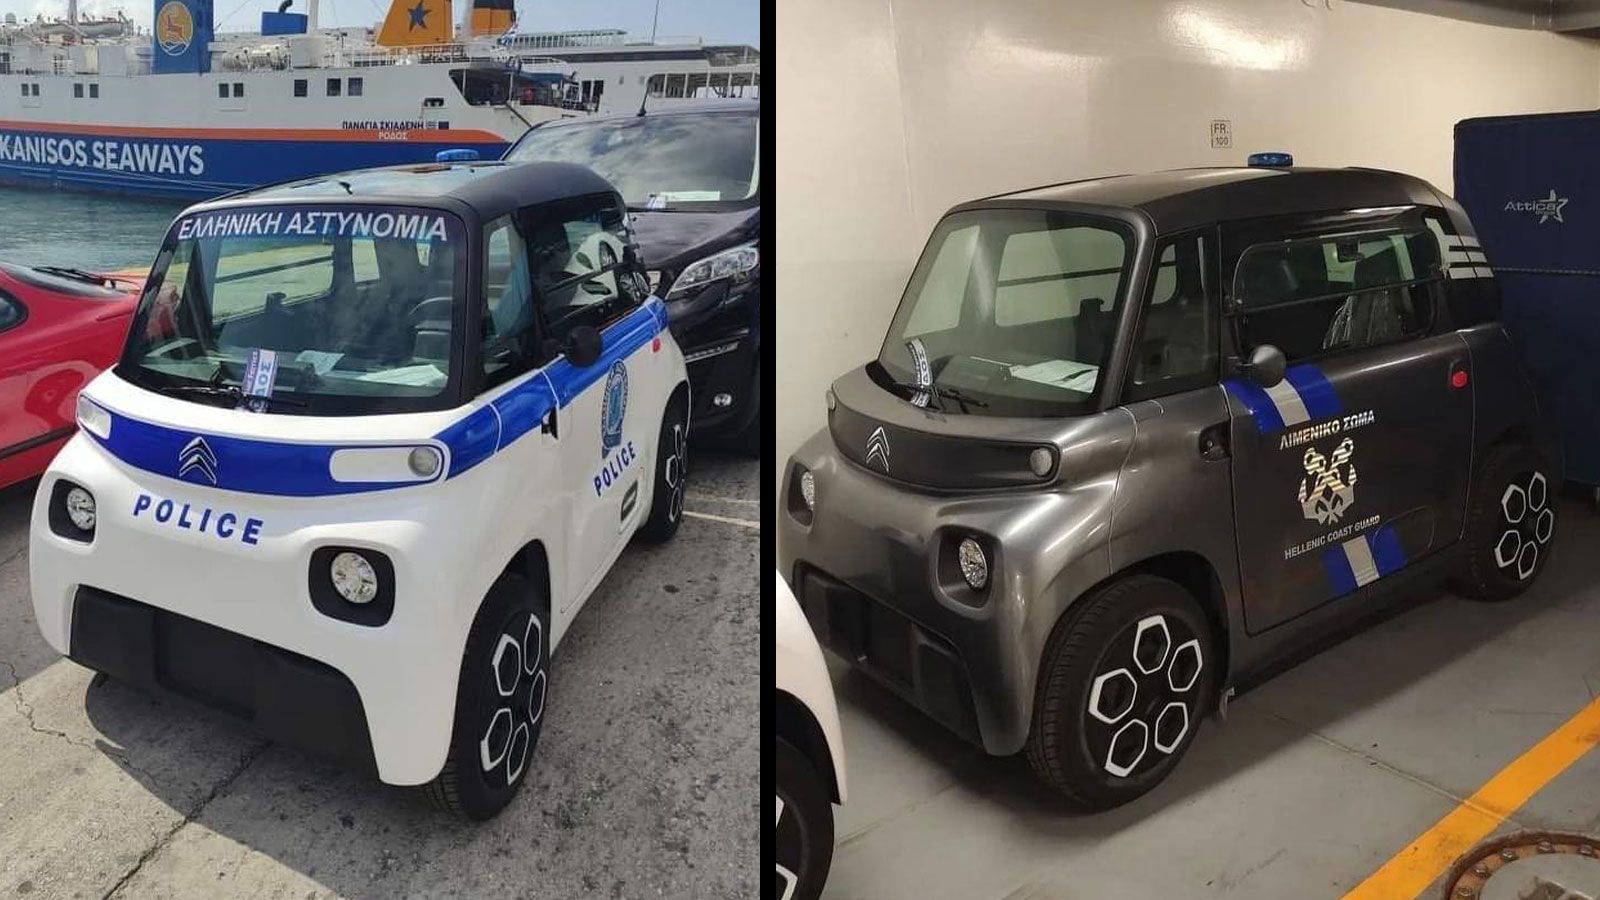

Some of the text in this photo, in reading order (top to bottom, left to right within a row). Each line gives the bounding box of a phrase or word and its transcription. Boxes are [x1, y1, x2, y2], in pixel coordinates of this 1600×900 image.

[342, 121, 424, 131] ΠΑΝΑΓΙΑ ΣΚΙΑΔΕΝΗ
[378, 131, 408, 140] ΡΟΔΟΣ
[0, 134, 205, 175] KANISOS SEAWAYS
[178, 212, 448, 242] ΕΛΛΗΝΙΚΗ ΑΣΤΥΝΟΜΙΑ
[1279, 410, 1376, 450] ΛΙΜΕΝΙΚΟ ΣΩΜΑ
[594, 441, 636, 497] POLICE
[132, 494, 264, 546] POLICE
[1283, 514, 1381, 560] HELLENIC COAST GUARD
